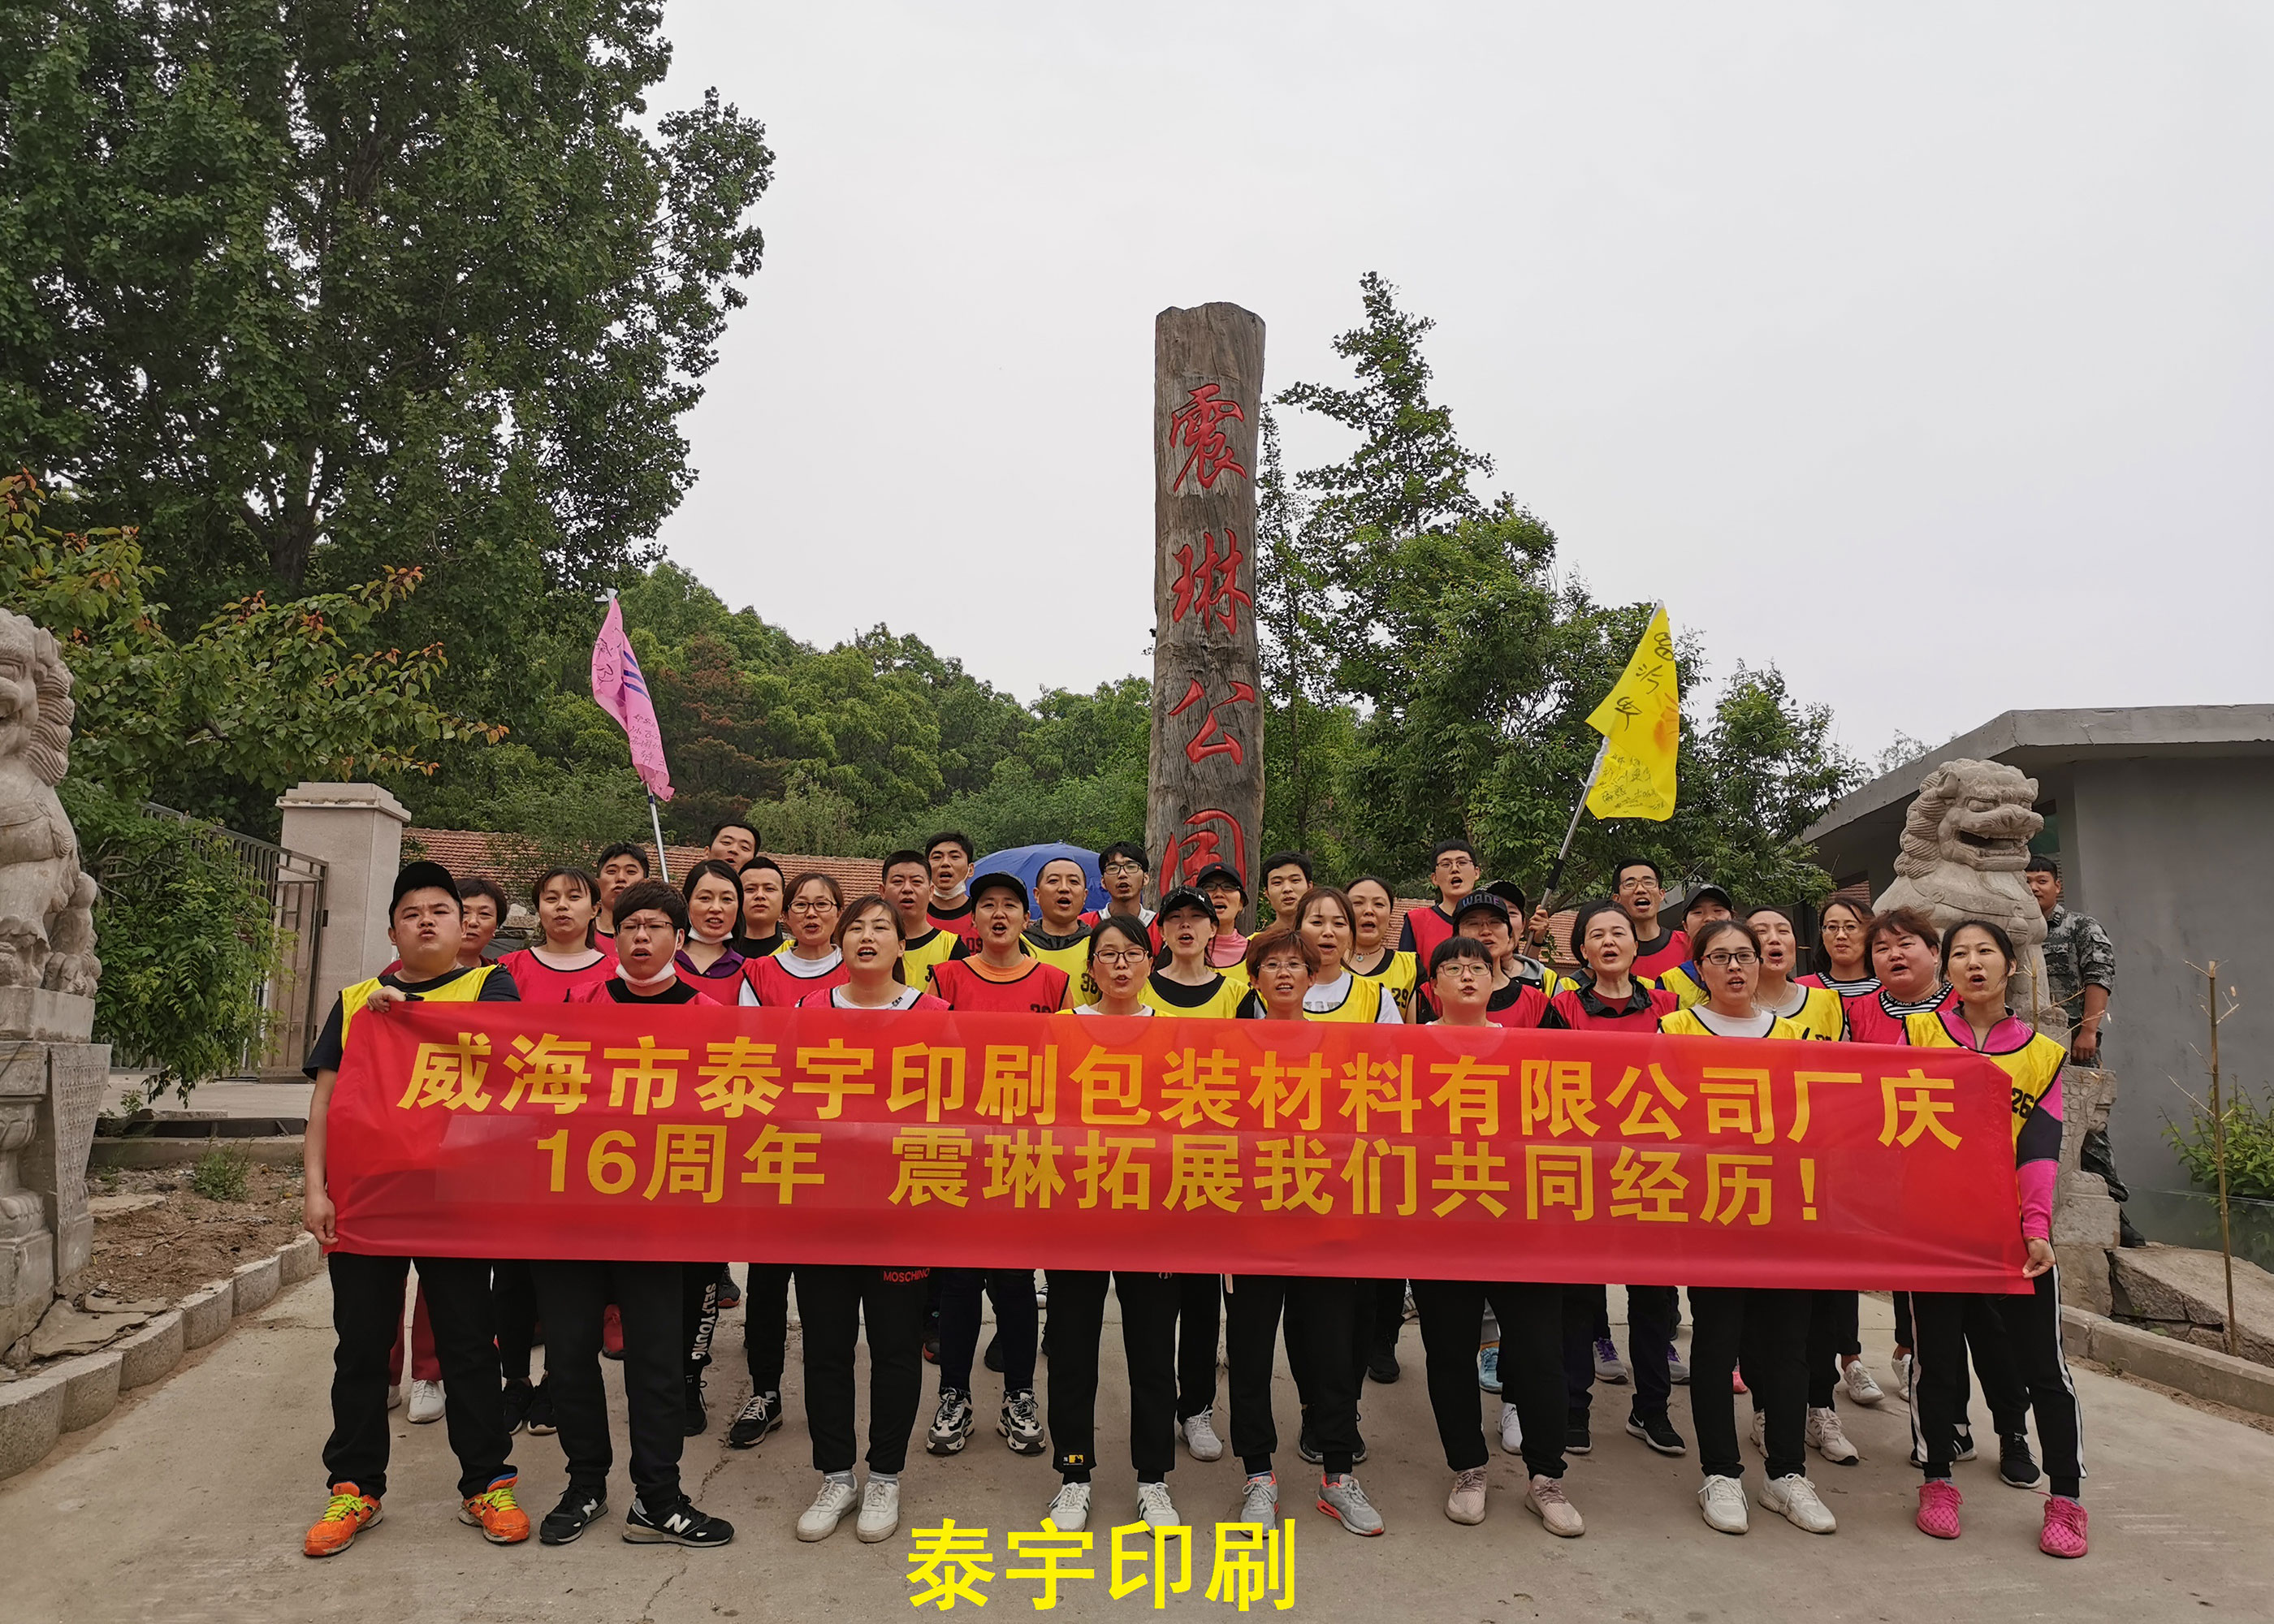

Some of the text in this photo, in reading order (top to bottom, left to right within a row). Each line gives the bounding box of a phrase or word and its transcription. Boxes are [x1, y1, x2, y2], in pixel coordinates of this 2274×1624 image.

[1463, 894, 1501, 908] WADE
[1391, 987, 1408, 1008] 29
[398, 1033, 1962, 1149] 威海市泰宇印刷包装材料有限公司厂庆
[2012, 1086, 2034, 1120] 26
[538, 1125, 825, 1204] 16周年
[883, 1268, 930, 1282] MOSCHINO
[663, 1513, 692, 1534] N
